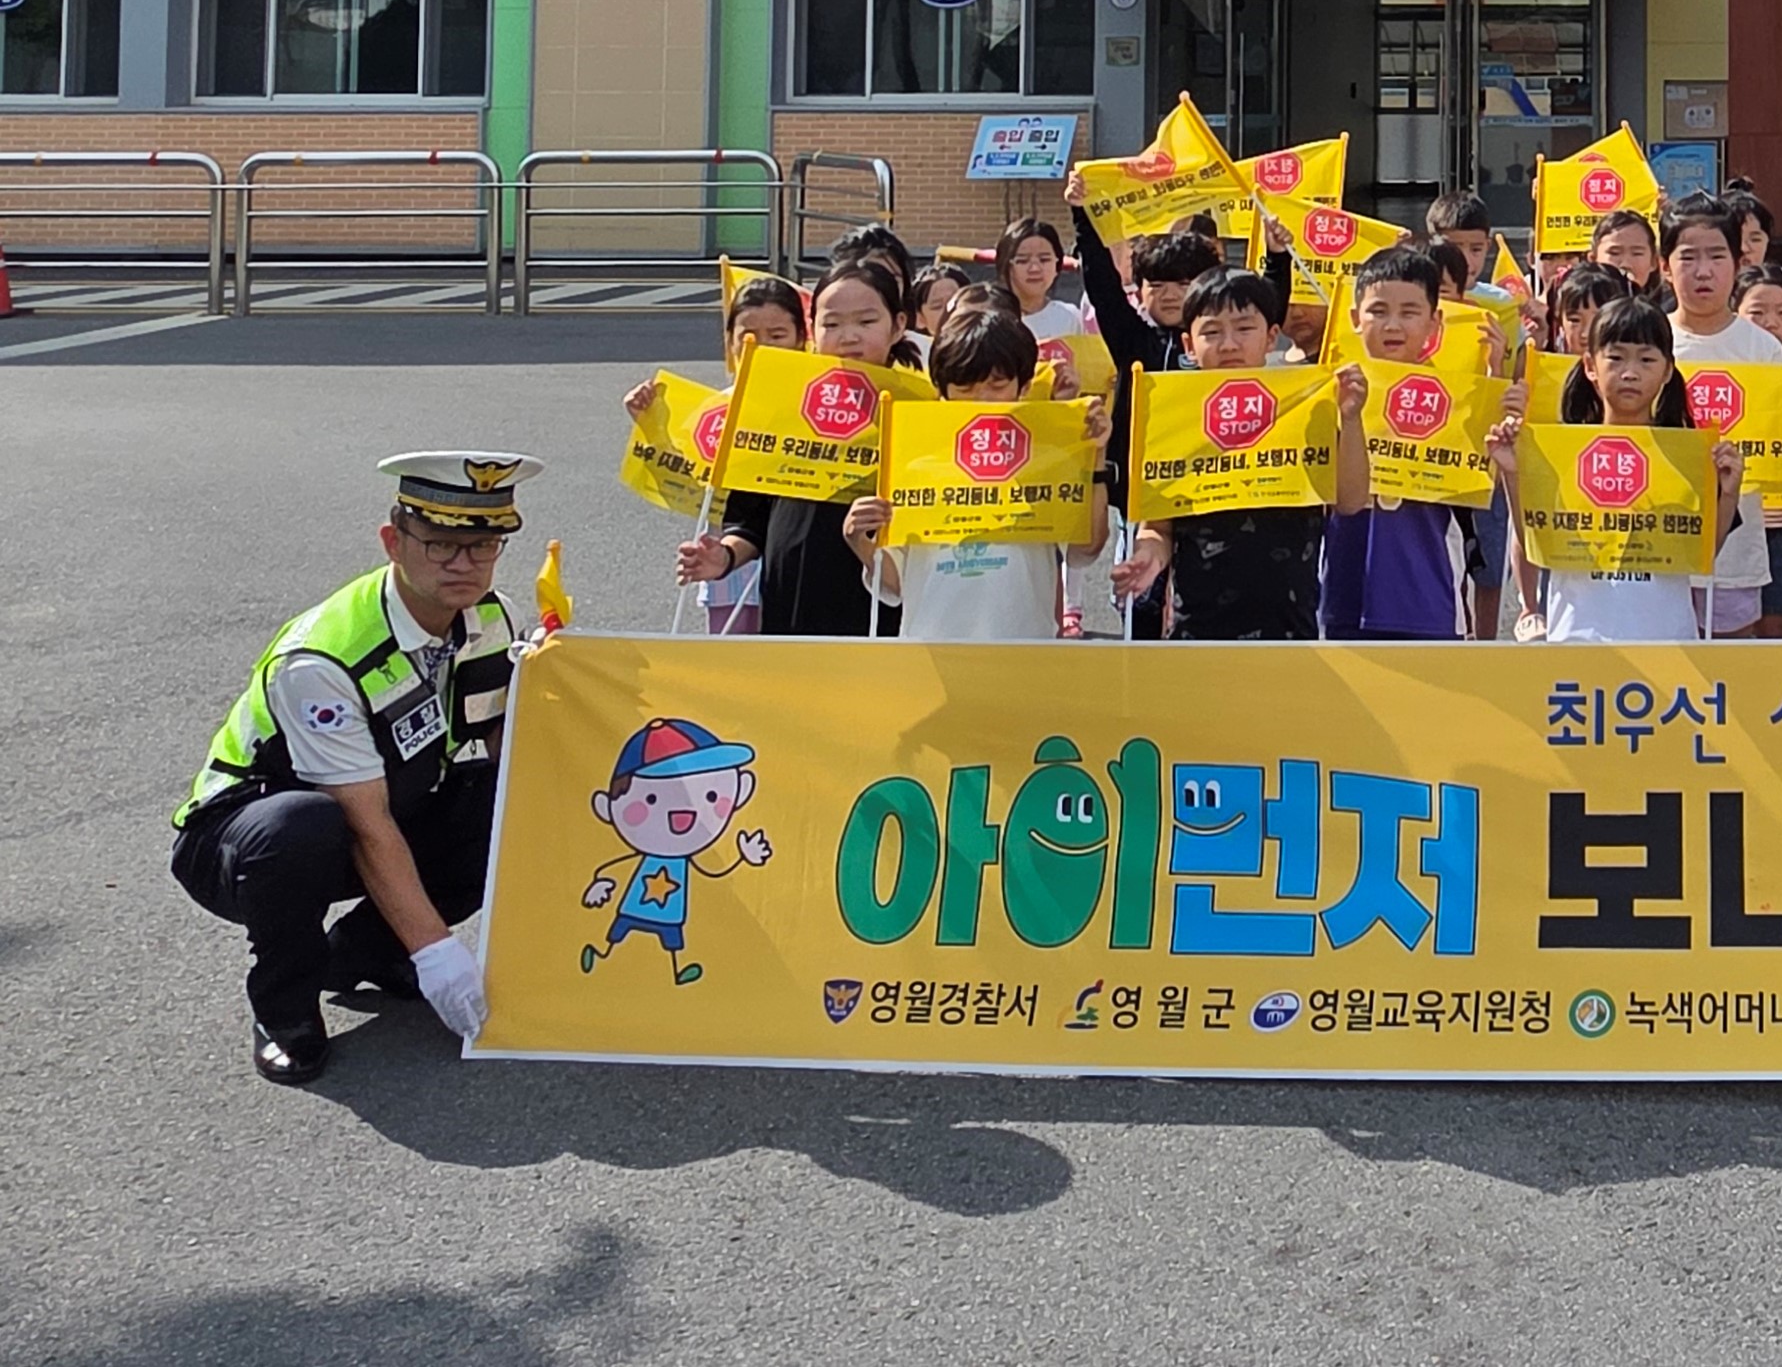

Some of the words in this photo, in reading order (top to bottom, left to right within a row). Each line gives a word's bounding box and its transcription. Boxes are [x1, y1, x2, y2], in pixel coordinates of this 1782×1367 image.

[1314, 216, 1348, 234] 정지
[1314, 234, 1347, 246] STOP
[820, 383, 864, 410] 정지
[1399, 388, 1439, 411] 정지
[1692, 385, 1732, 406] 정지
[815, 407, 859, 425] STOP
[1218, 395, 1263, 420] 정지
[1396, 409, 1435, 426] STOP
[1693, 408, 1732, 422] STOP
[969, 428, 1017, 451] 정지
[1218, 419, 1262, 437] STOP
[734, 430, 776, 453] 안전한
[782, 437, 839, 462] 우리동네,
[969, 451, 1015, 468] STOP
[1144, 459, 1186, 481] 안전한
[1192, 454, 1250, 476] 우리동네,
[1256, 448, 1297, 468] 보행자
[1303, 446, 1330, 465] 우선
[1424, 446, 1461, 465] 보행자
[1466, 452, 1490, 471] 우선
[892, 486, 936, 507] 안전한
[942, 486, 1003, 507] 우리동네,
[1009, 484, 1052, 505] 보행자
[1058, 483, 1085, 504] 우선
[1546, 680, 1728, 765] 최우선
[404, 721, 442, 753] POLICE
[870, 980, 1039, 1026] 영월경찰서
[1307, 988, 1551, 1033] 영월교육지원청
